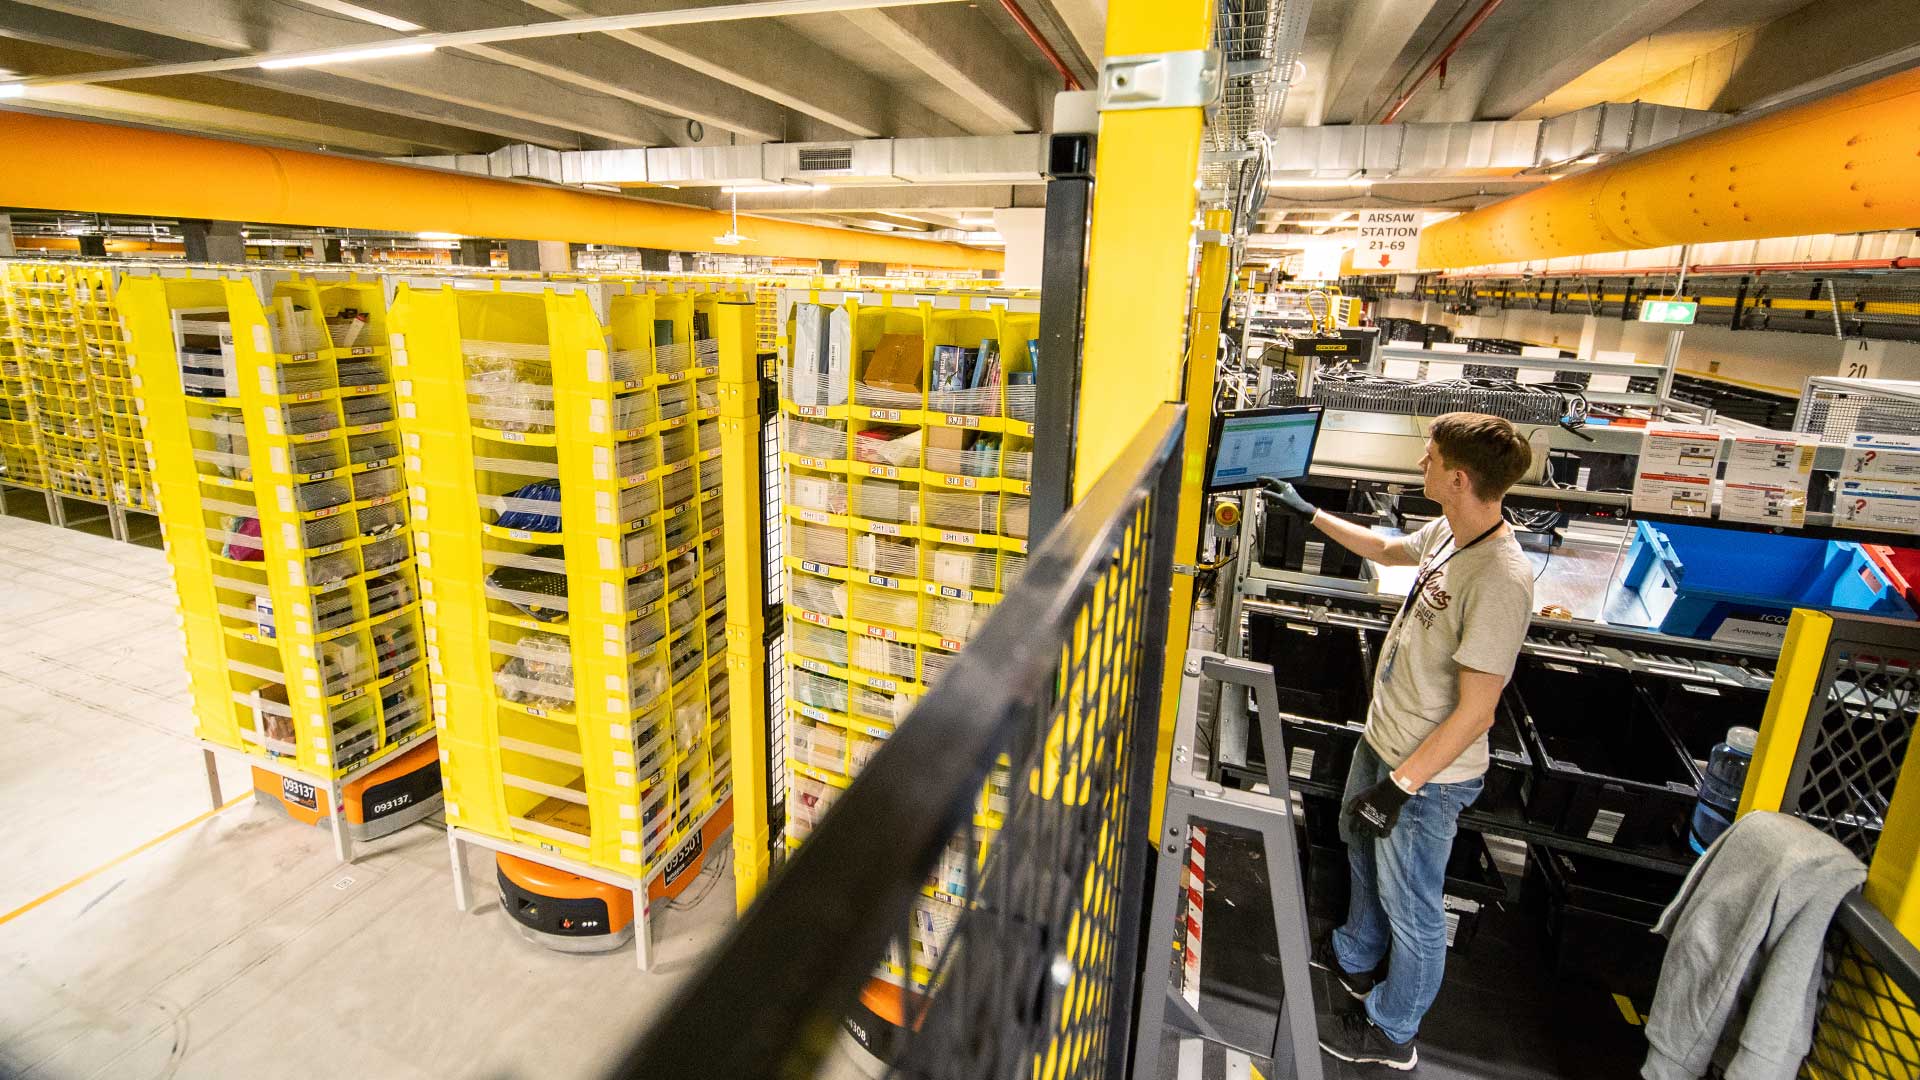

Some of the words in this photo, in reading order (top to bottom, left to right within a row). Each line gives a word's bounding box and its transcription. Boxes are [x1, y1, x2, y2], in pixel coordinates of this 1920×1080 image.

[1368, 213, 1415, 223] ARSAW
[1361, 227, 1418, 237] STATION
[1369, 241, 1405, 250] 21-69
[283, 778, 314, 798] 093137
